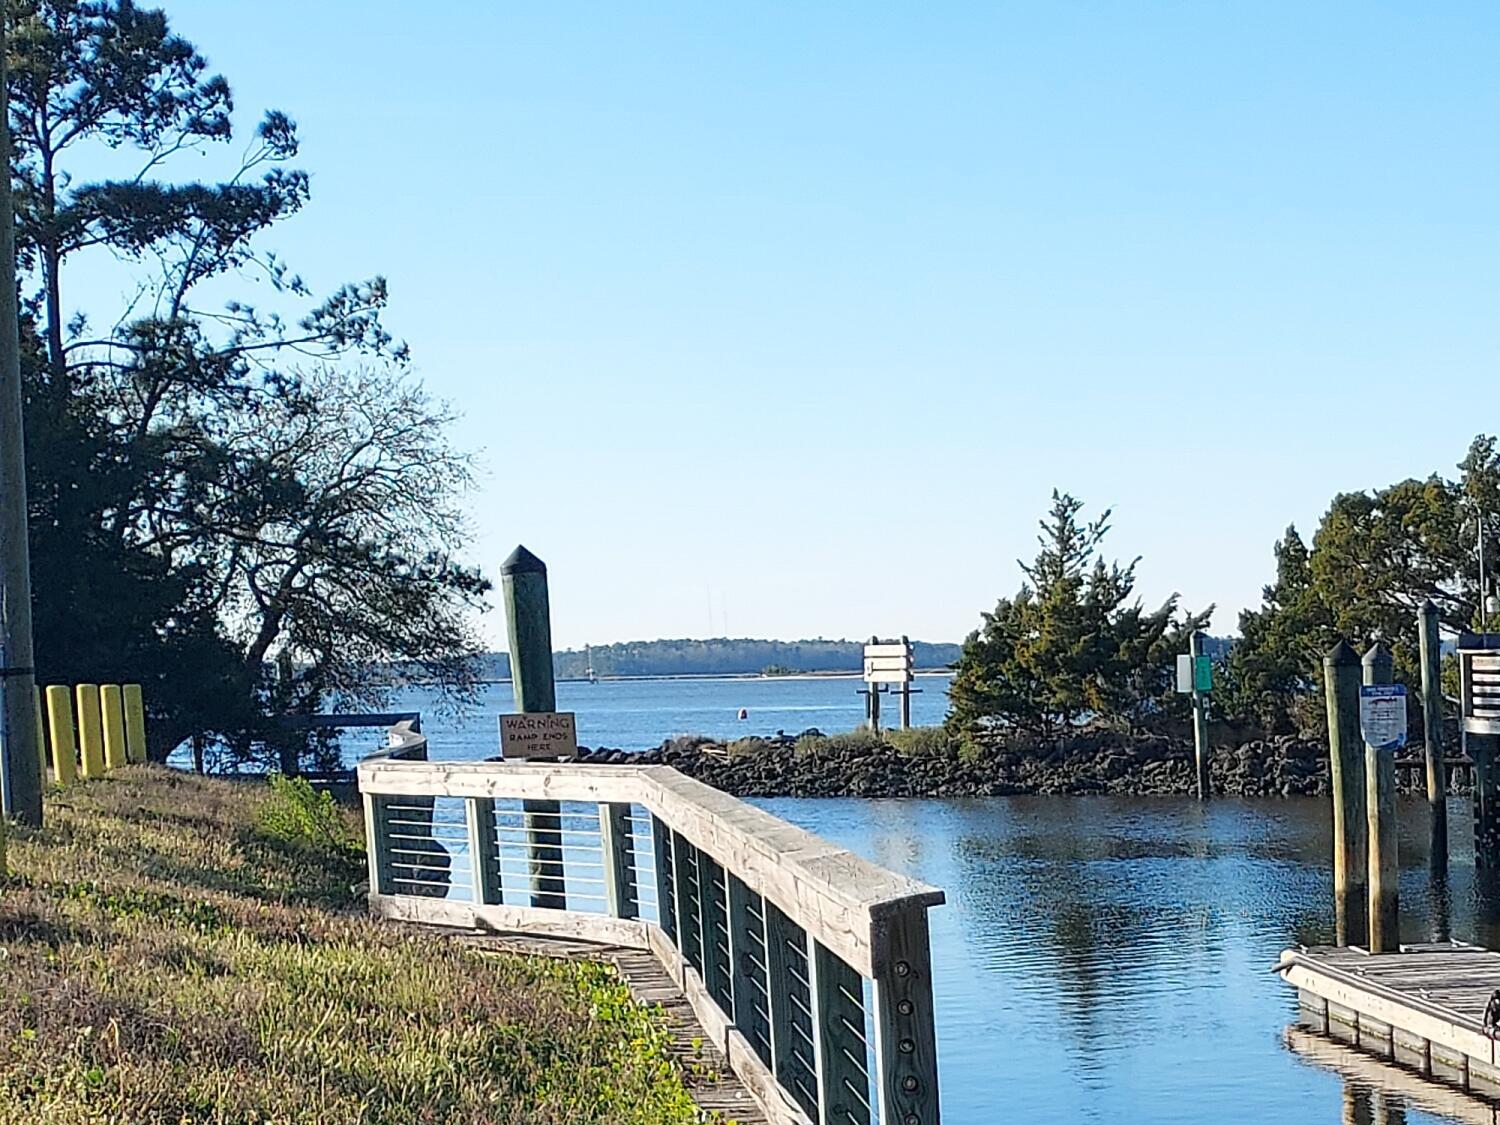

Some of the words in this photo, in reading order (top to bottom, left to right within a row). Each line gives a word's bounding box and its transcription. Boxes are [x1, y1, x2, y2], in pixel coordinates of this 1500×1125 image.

[506, 718, 570, 730] WARNING
[509, 733, 538, 742] RAMP
[543, 732, 568, 741] ENDS
[527, 743, 552, 752] HERE
